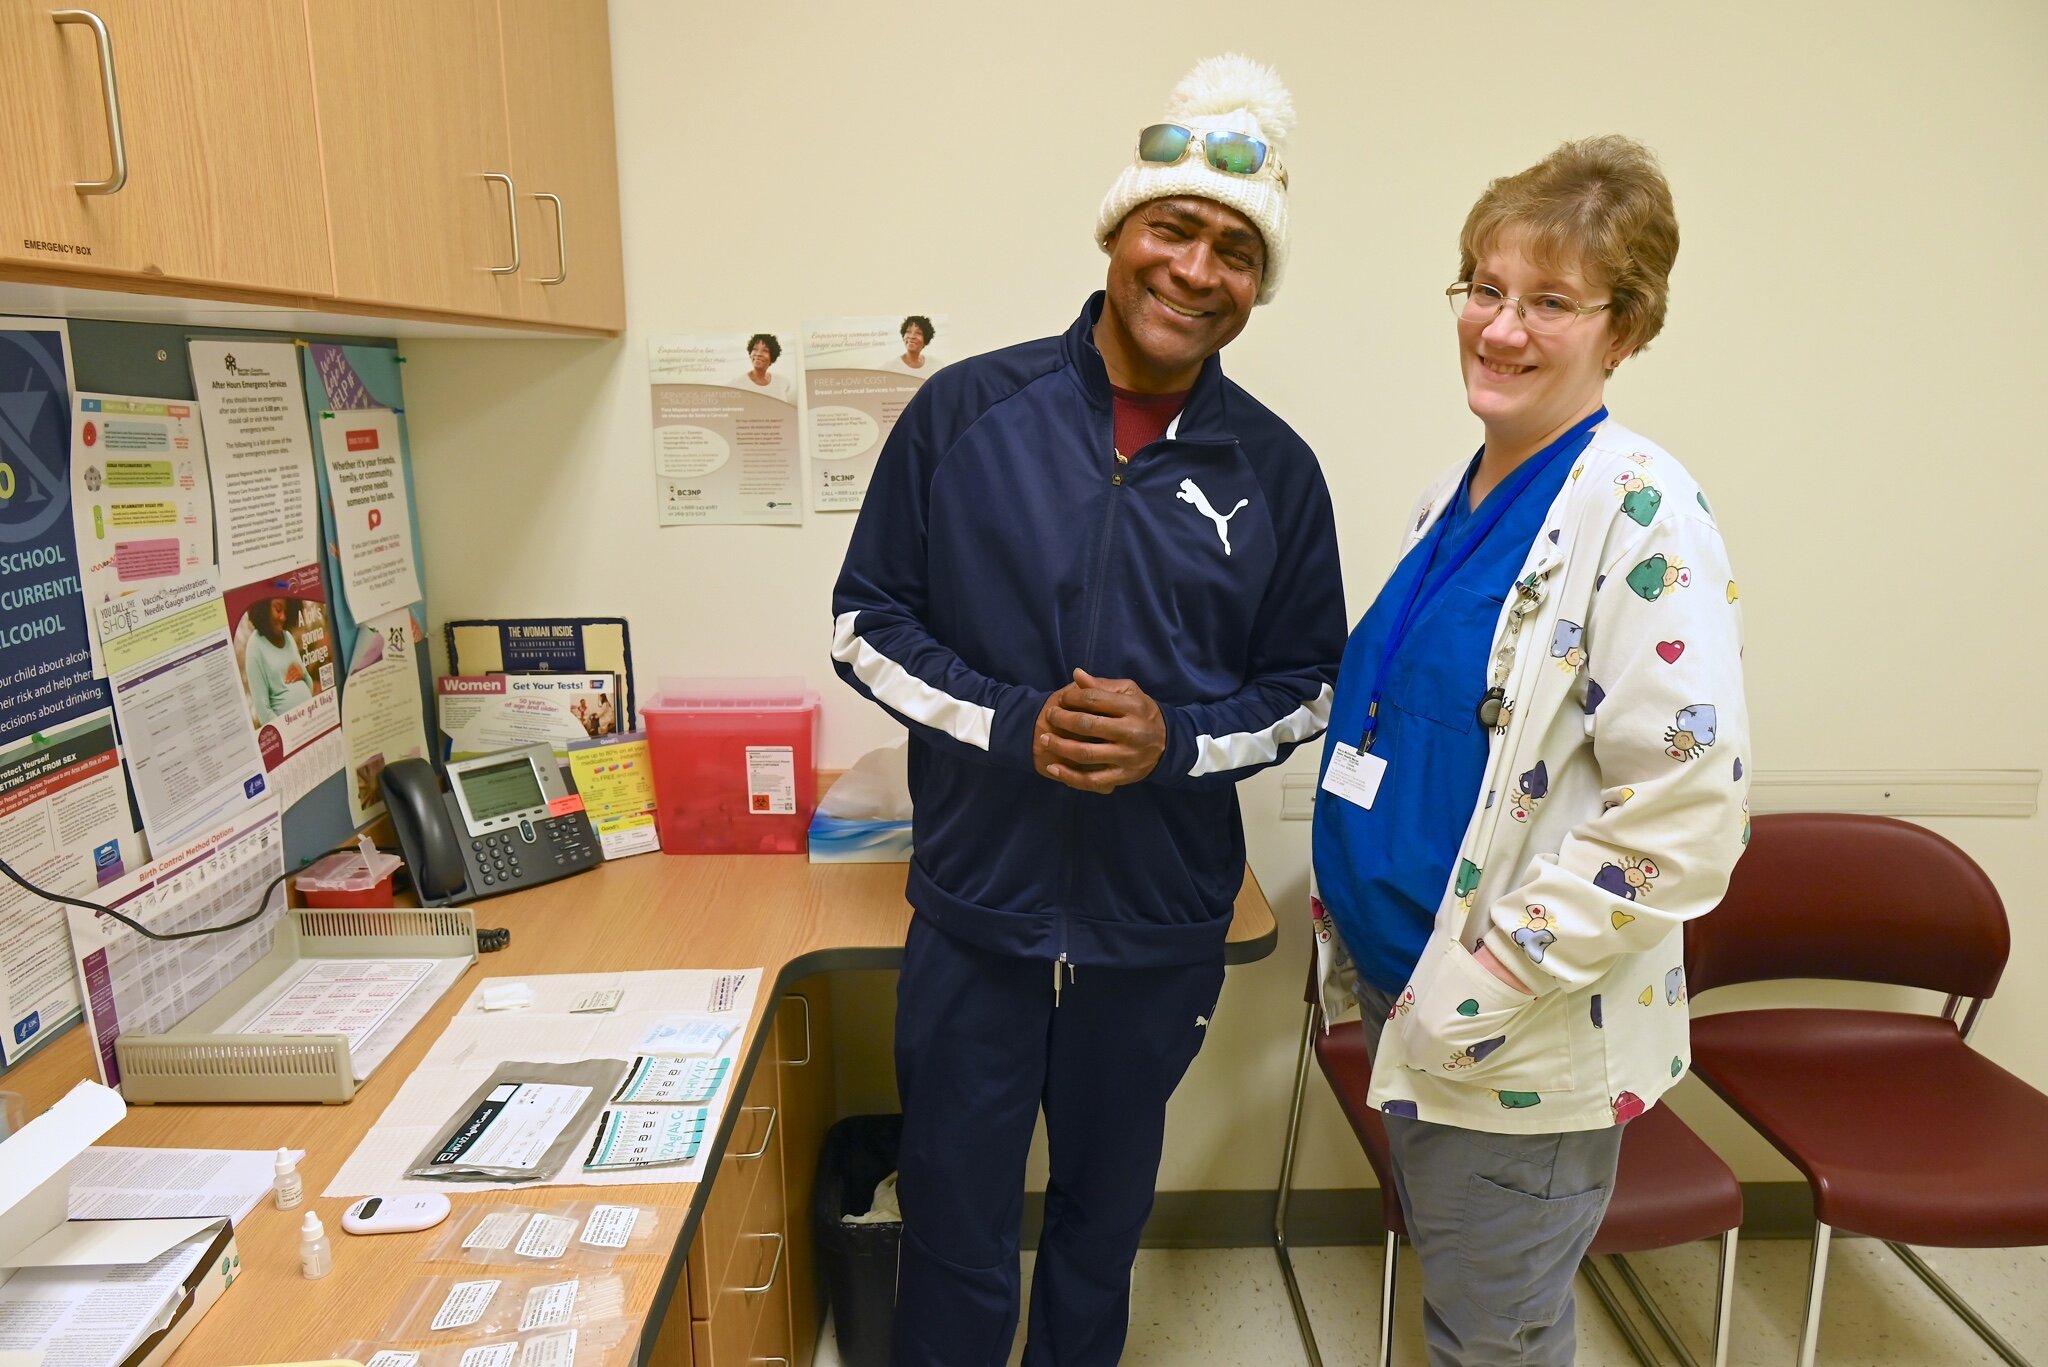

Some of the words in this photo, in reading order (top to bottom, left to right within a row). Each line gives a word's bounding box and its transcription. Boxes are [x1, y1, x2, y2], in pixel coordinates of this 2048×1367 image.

[24, 240, 73, 253] EMERGENCY
[76, 246, 91, 255] BOX
[212, 381, 225, 389] After
[242, 381, 268, 389] Emergency
[815, 377, 833, 386] FREE
[841, 377, 861, 386] LOW
[864, 376, 888, 384] COST
[332, 461, 356, 471] Whether
[357, 459, 365, 468] it's
[366, 459, 377, 469] your
[350, 483, 373, 494] everyone
[374, 480, 388, 490] needs
[347, 497, 369, 507] someone
[370, 495, 375, 503] to
[0, 545, 66, 575] SCHOOL
[1, 576, 82, 611] CURRENTL
[144, 602, 164, 616] Needle
[165, 598, 184, 610] Gauge
[185, 593, 196, 602] and
[196, 585, 216, 598] Length
[101, 609, 111, 619] YOU
[112, 603, 123, 613] CALL
[298, 610, 304, 627] A
[0, 614, 66, 650] LCOHOL
[302, 627, 323, 650] gonna
[508, 627, 521, 637] THE
[523, 626, 550, 637] WOMAN
[552, 626, 574, 637] INSIDE
[14, 665, 36, 683] child
[38, 658, 64, 675] about
[65, 648, 92, 666] alcoh
[302, 646, 328, 666] change
[17, 688, 33, 704] risk
[35, 682, 52, 698] and
[53, 676, 72, 693] help
[444, 679, 501, 691] Women
[513, 682, 530, 690] Get
[534, 682, 554, 690] Your
[0, 711, 37, 733] ecisions
[39, 701, 65, 718] about
[66, 687, 104, 707] drinking.
[285, 709, 305, 725] You've
[307, 700, 318, 718] got
[0, 765, 22, 780] rotect
[23, 753, 49, 770] Yourself
[26, 768, 41, 780] ZIKA
[42, 762, 62, 773] FROM
[63, 753, 77, 764] SEX
[139, 867, 157, 882] Birth
[158, 852, 185, 871] Control
[186, 839, 210, 857] Method
[211, 826, 234, 844] Options
[476, 1108, 493, 1124] Combo
